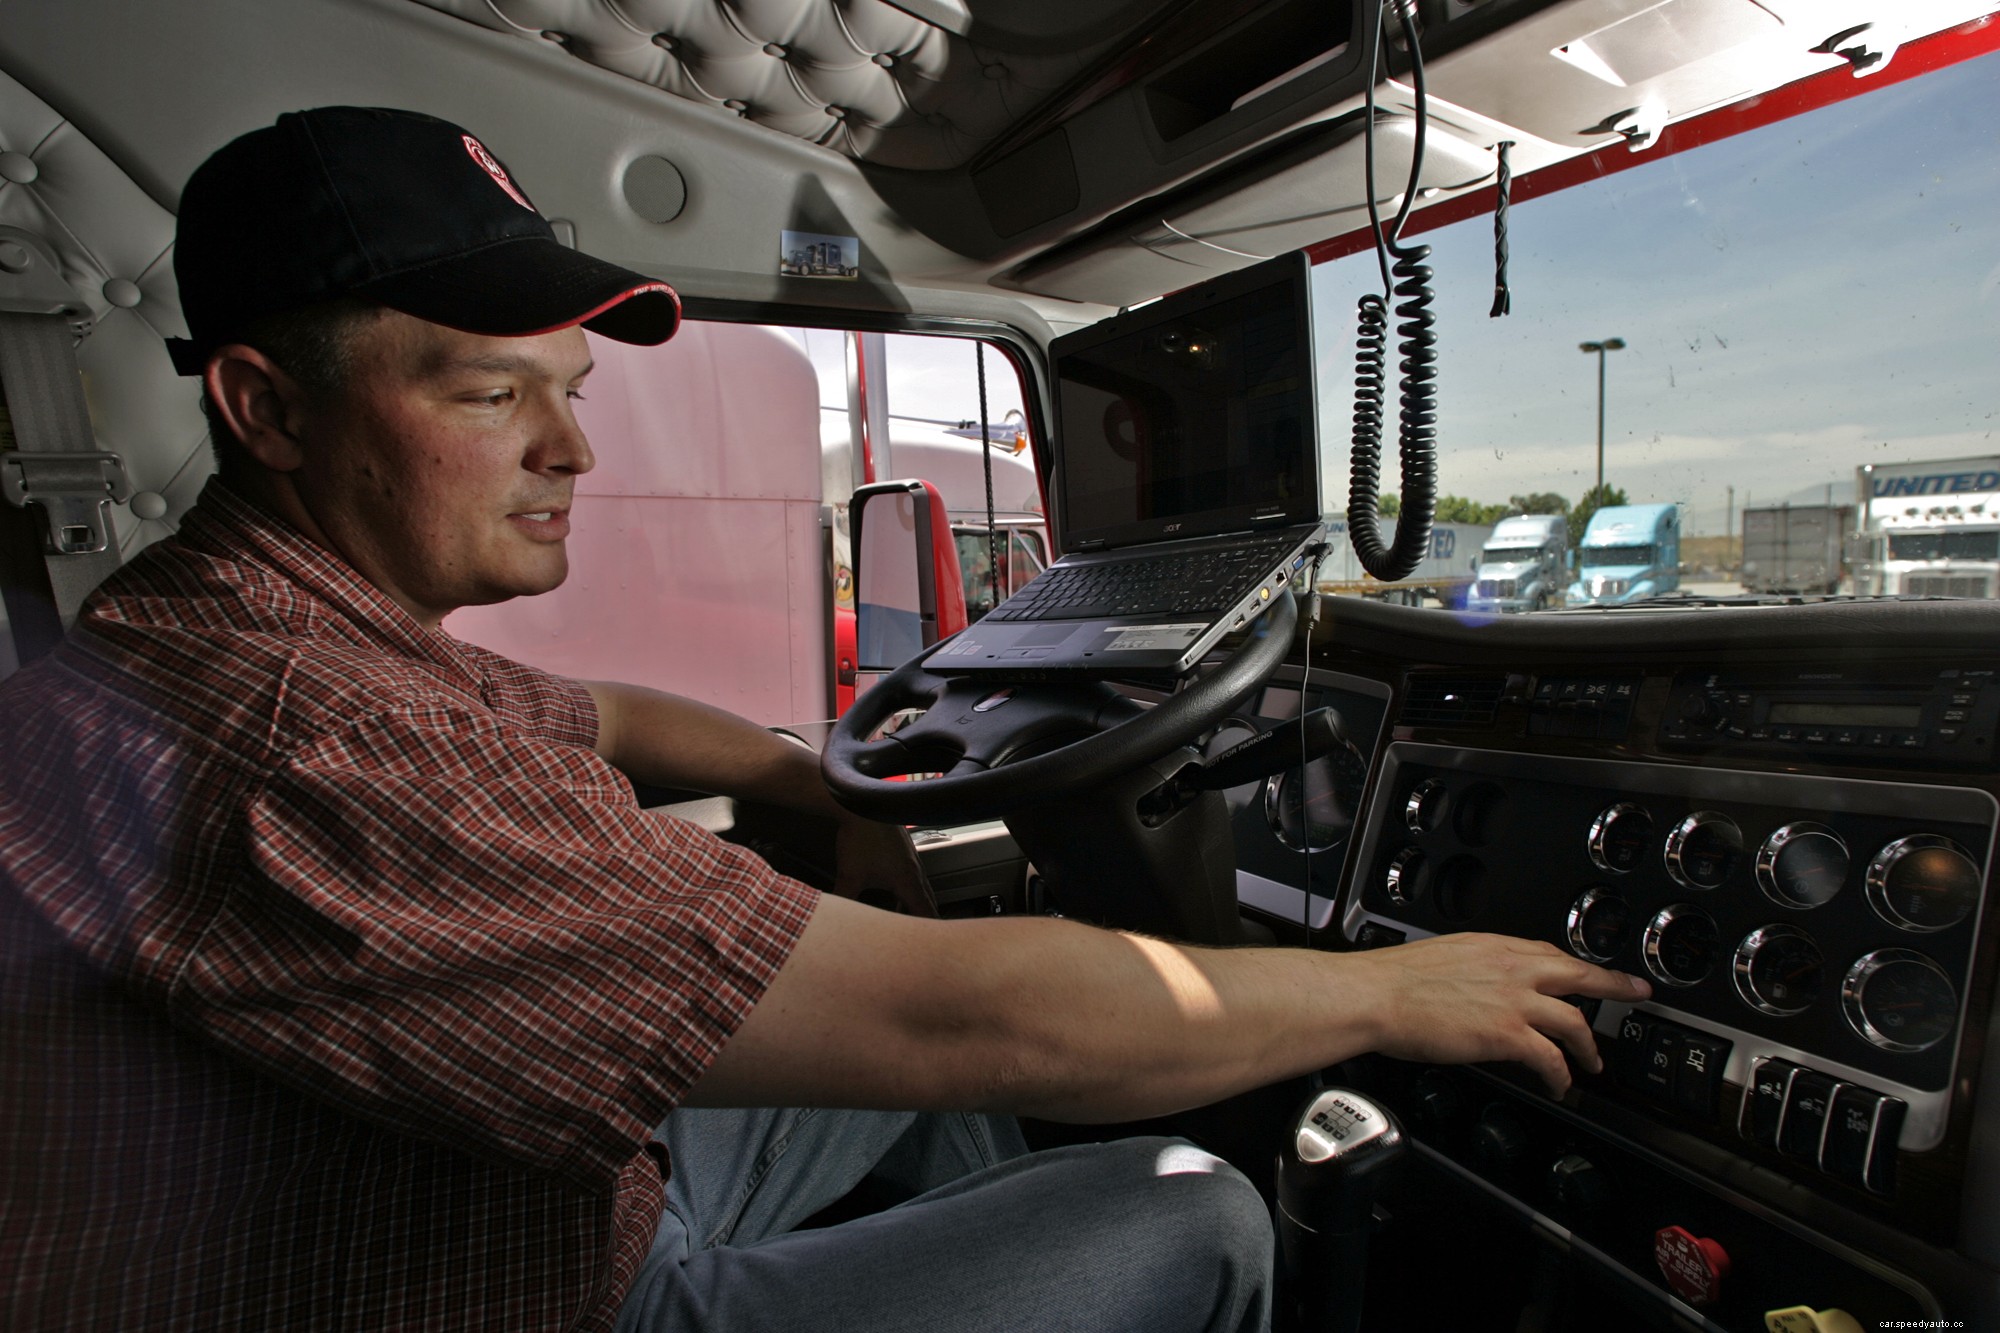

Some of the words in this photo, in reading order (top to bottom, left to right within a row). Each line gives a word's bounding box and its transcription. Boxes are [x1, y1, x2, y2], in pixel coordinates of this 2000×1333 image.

[1873, 470, 2000, 497] UNITED
[1220, 747, 1238, 761] FOR
[1238, 730, 1273, 752] PARKING
[1655, 1245, 1670, 1261] AIR
[1674, 1260, 1711, 1289] SUPPLY
[1663, 1239, 1704, 1276] TRAILER
